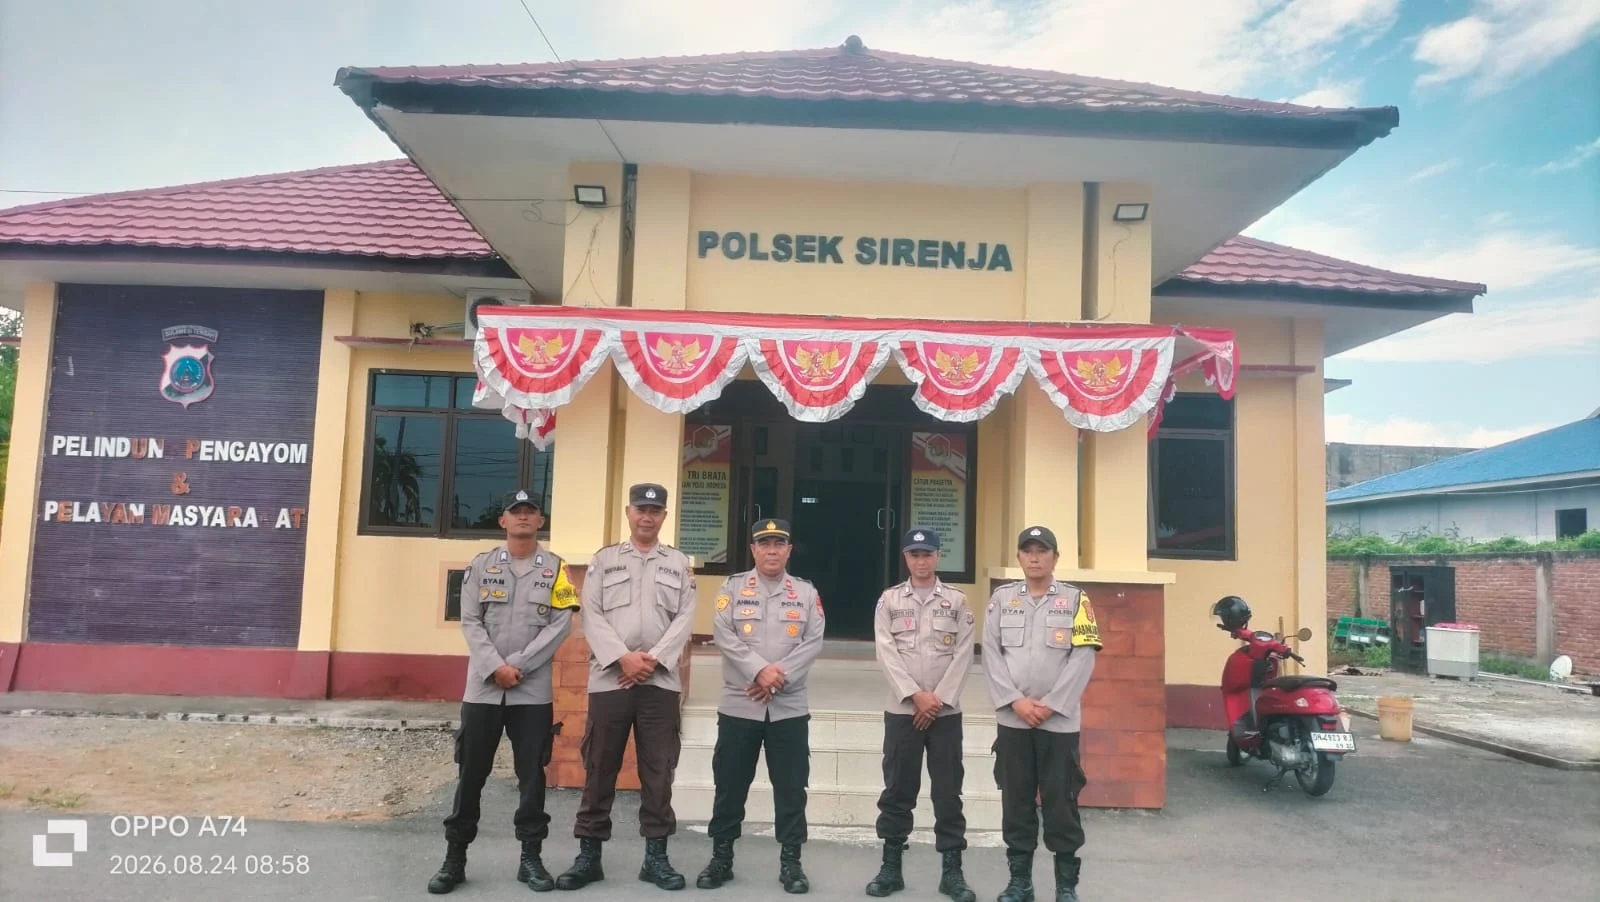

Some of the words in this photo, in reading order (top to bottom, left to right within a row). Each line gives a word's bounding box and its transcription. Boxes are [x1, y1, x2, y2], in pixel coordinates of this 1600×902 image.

[698, 230, 844, 264] POLSEK
[855, 236, 1013, 272] SIRENJA
[185, 439, 308, 463] PENGAYOM
[171, 472, 190, 495] &
[687, 470, 700, 480] TRI
[702, 471, 727, 481] BRATA
[44, 501, 145, 524] PELAYAN
[659, 566, 680, 577] POLRI
[534, 581, 551, 589] POL
